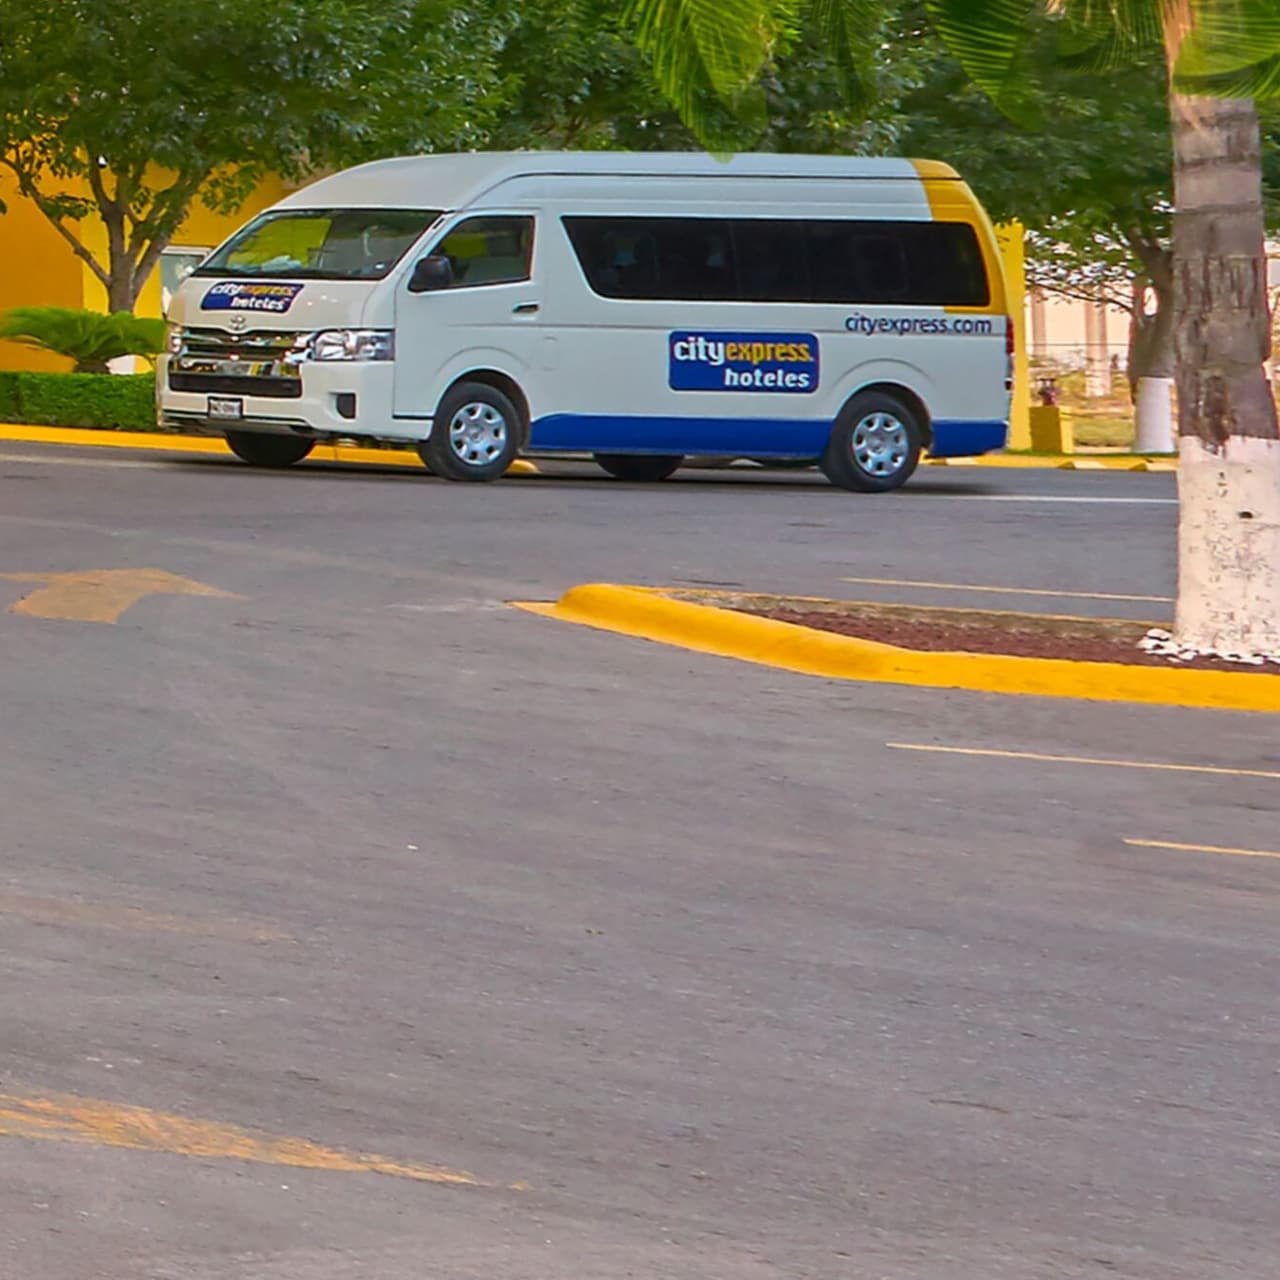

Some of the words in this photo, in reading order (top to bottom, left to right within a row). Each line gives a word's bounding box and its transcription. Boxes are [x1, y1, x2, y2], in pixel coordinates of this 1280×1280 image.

[230, 297, 284, 310] hoteles
[845, 312, 992, 336] cityexpress.com
[673, 336, 811, 365] cityexpress
[724, 368, 811, 388] hoteles
